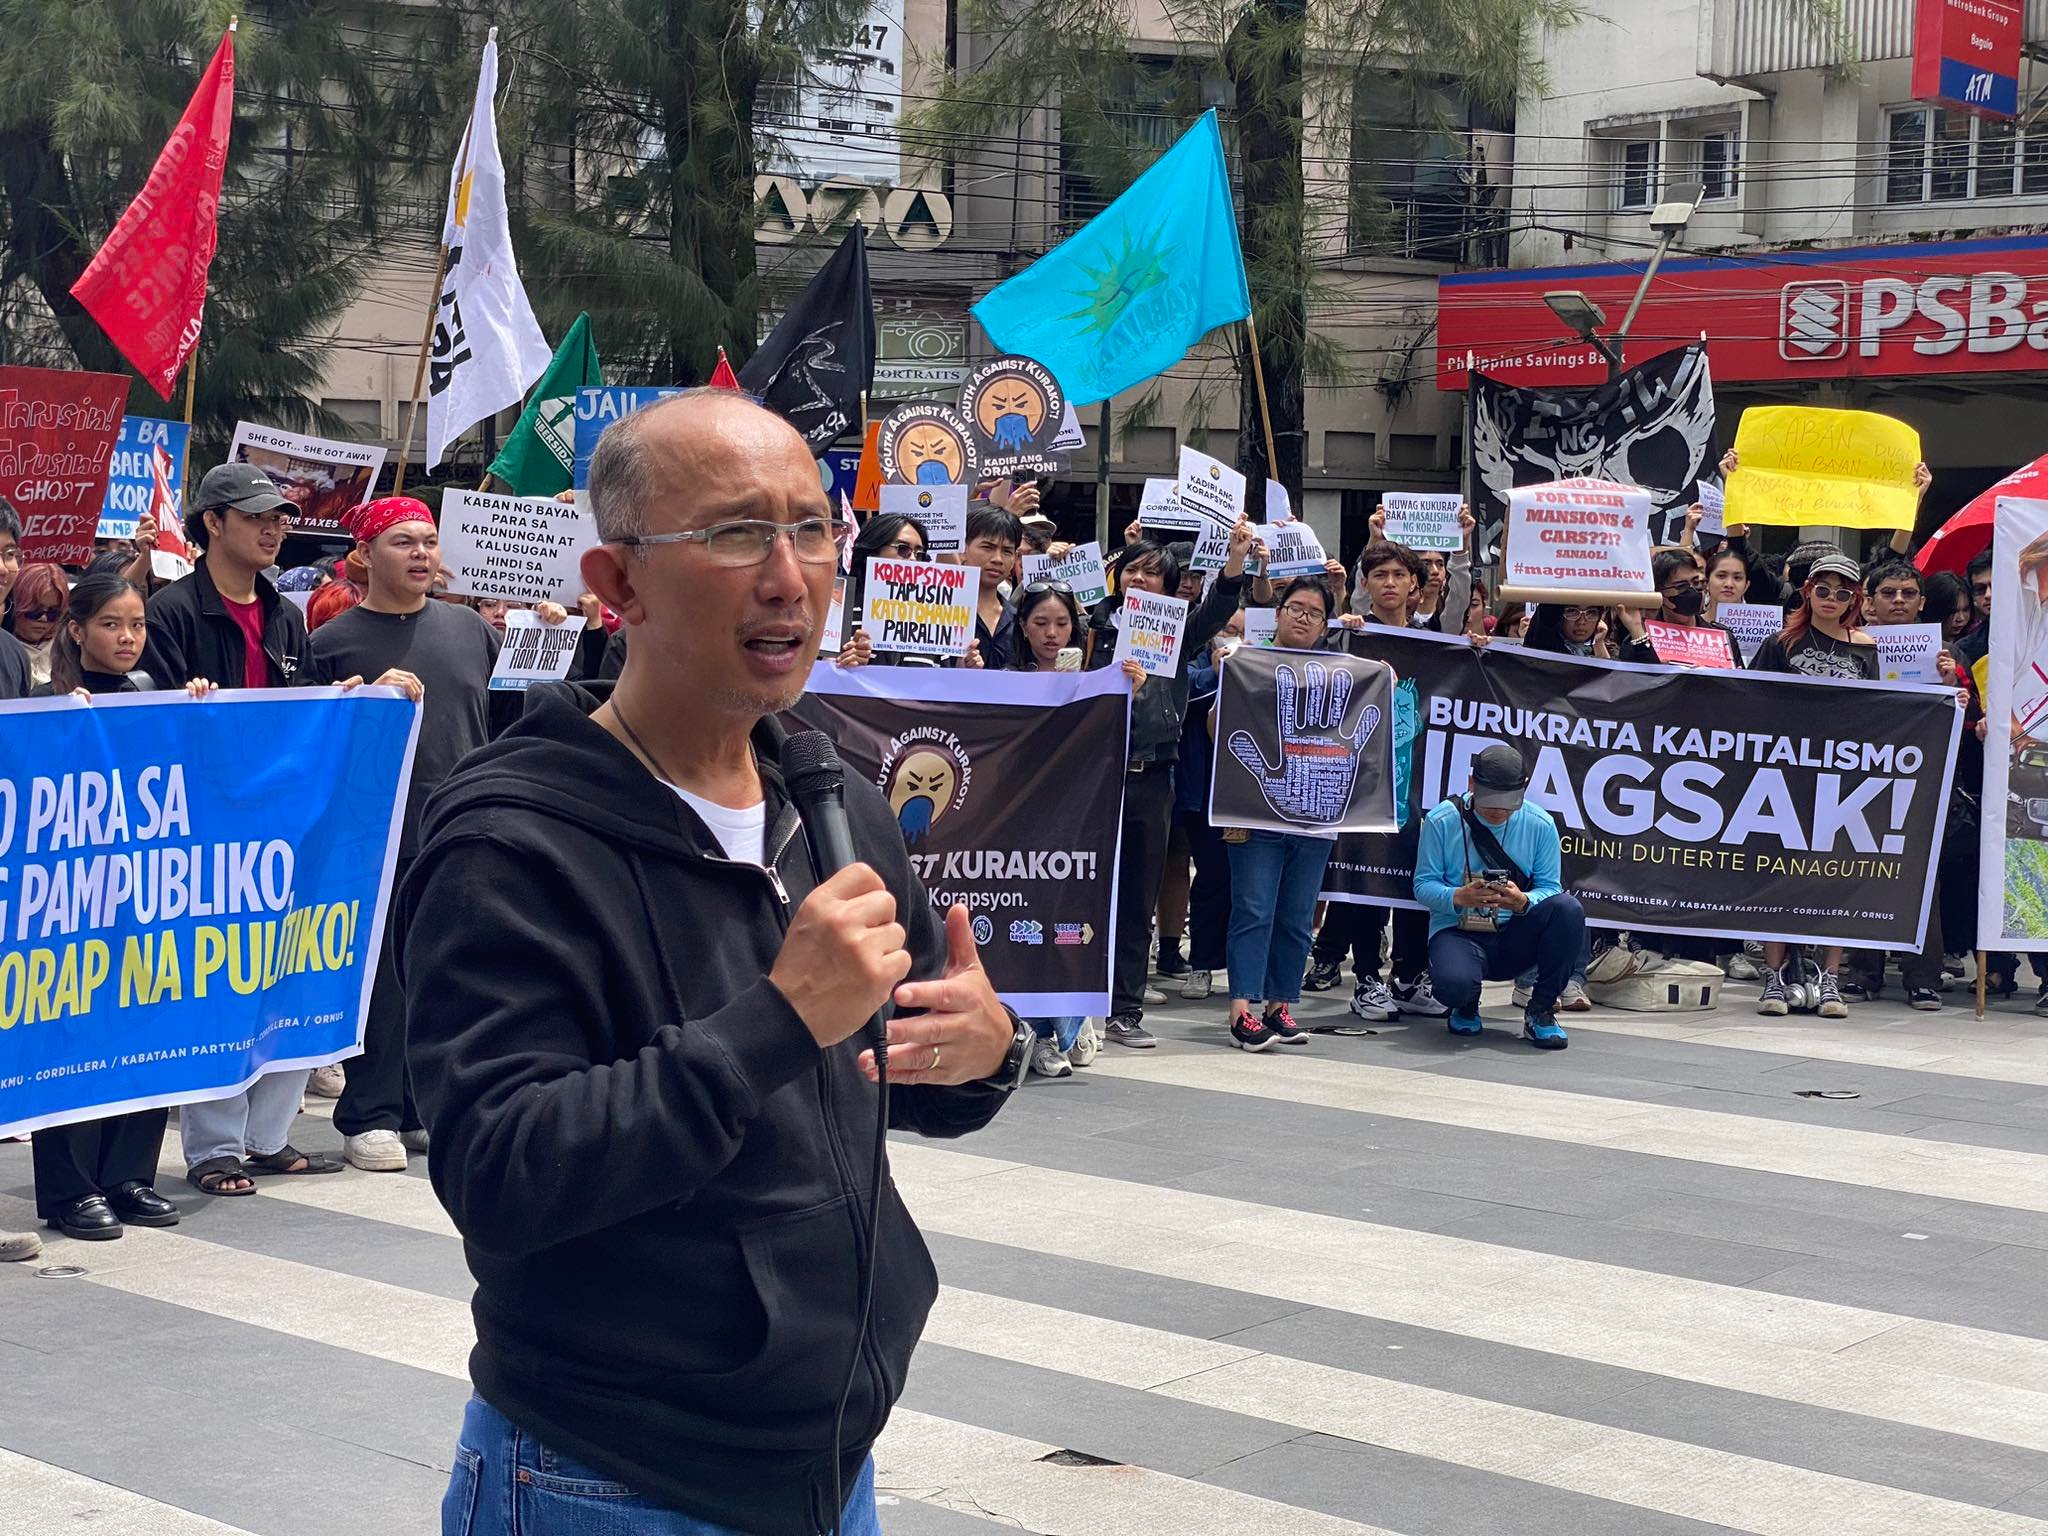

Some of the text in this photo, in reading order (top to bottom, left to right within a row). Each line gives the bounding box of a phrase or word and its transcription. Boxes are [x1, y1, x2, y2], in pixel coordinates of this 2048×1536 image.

[1987, 9, 2009, 26] Group
[1971, 33, 1993, 50] Baguio
[1965, 73, 1994, 102] ATM
[1447, 354, 1523, 371] Phippine
[1526, 352, 1585, 369] Savings
[874, 369, 960, 380] PORTRAITS
[962, 384, 976, 424] OUTH
[888, 405, 940, 432] AGAINST
[248, 432, 268, 444] SHE
[304, 445, 322, 455] SHE
[324, 449, 344, 458] GOT
[345, 452, 372, 462] AWAY
[884, 431, 896, 480] YOUTH
[1020, 454, 1043, 463] ANG
[15, 479, 95, 506] GHOST
[1190, 475, 1233, 501] KADIRI ANG
[463, 495, 580, 520] KABAN NG BAYAN
[1187, 483, 1235, 513] KORAPSYON!
[1388, 499, 1458, 512] HUWAG KUKURAP
[1535, 491, 1625, 507] FOR THEIR
[304, 517, 339, 528] TAXES
[491, 514, 548, 530] PARA SA
[1386, 510, 1407, 521] BAKA
[1526, 509, 1634, 529] MANSIONS &
[461, 523, 575, 547] KARUNUNGAN AT
[1403, 522, 1442, 534] NG KORAP
[1540, 529, 1622, 546] CARS??!?
[475, 539, 558, 558] KALUSUGAN
[1198, 541, 1224, 556] ANG
[1277, 532, 1303, 548] JUNK
[1395, 535, 1451, 547] AKMA UP
[486, 556, 543, 572] HINDI SA
[1070, 549, 1087, 564] FOR
[1268, 547, 1295, 564] RROR
[1556, 549, 1608, 560] SANAOL!
[461, 566, 564, 588] KURAPSYON AT
[874, 562, 965, 588] KORAPSIYON
[1055, 564, 1081, 580] CRISIS
[1082, 560, 1100, 574] FOR
[1513, 562, 1646, 580] #magnanakaw
[471, 581, 551, 600] KASAKIMAN
[886, 580, 954, 605] TAPUSIN
[1080, 590, 1096, 601] UP
[1126, 595, 1141, 611] TAX
[1719, 617, 1781, 628] PROTESTA ANG
[1727, 608, 1775, 619] BAHAIN NG
[1129, 614, 1176, 636] LIFESTYLE NIYO
[520, 628, 542, 649] OUR
[541, 628, 578, 650] RIVERS
[1648, 624, 1724, 648] DPWH
[1877, 644, 1928, 654] NINAKAW
[1885, 654, 1916, 663] NIYO!
[536, 650, 561, 671] FREE
[1800, 660, 1824, 674] LAS
[1285, 688, 1294, 735] corruption
[890, 726, 947, 755] AGAINST
[1429, 695, 1642, 752] BURUKRATA
[1652, 724, 1924, 775] KAPITALISMO
[26, 767, 130, 854] PARA
[136, 763, 190, 841] SA
[942, 850, 1097, 881] KURAKOT!
[1354, 864, 1411, 877] ANAKBAYAN
[1632, 843, 1745, 871] DUTERTE
[1756, 854, 1901, 880] PANAGUTIN!
[17, 838, 296, 942] PAMPUBLIKO,
[928, 887, 1029, 912] Korapsyon.
[1582, 890, 1602, 900] KMU
[1611, 894, 1669, 907] CORDILLERA
[1679, 901, 1732, 912] KABATAAN
[1734, 905, 1783, 913] PARTYLIST
[1793, 907, 1850, 917] CORDILLERA
[1861, 911, 1895, 921] ORNUS
[119, 929, 182, 1009] NA
[0, 1075, 24, 1090] KMU
[35, 1059, 108, 1083] CORDILLERA
[121, 1045, 188, 1067] KABATAAN
[191, 1037, 256, 1056] PARTYLIST
[314, 1011, 344, 1025] ORNUS
